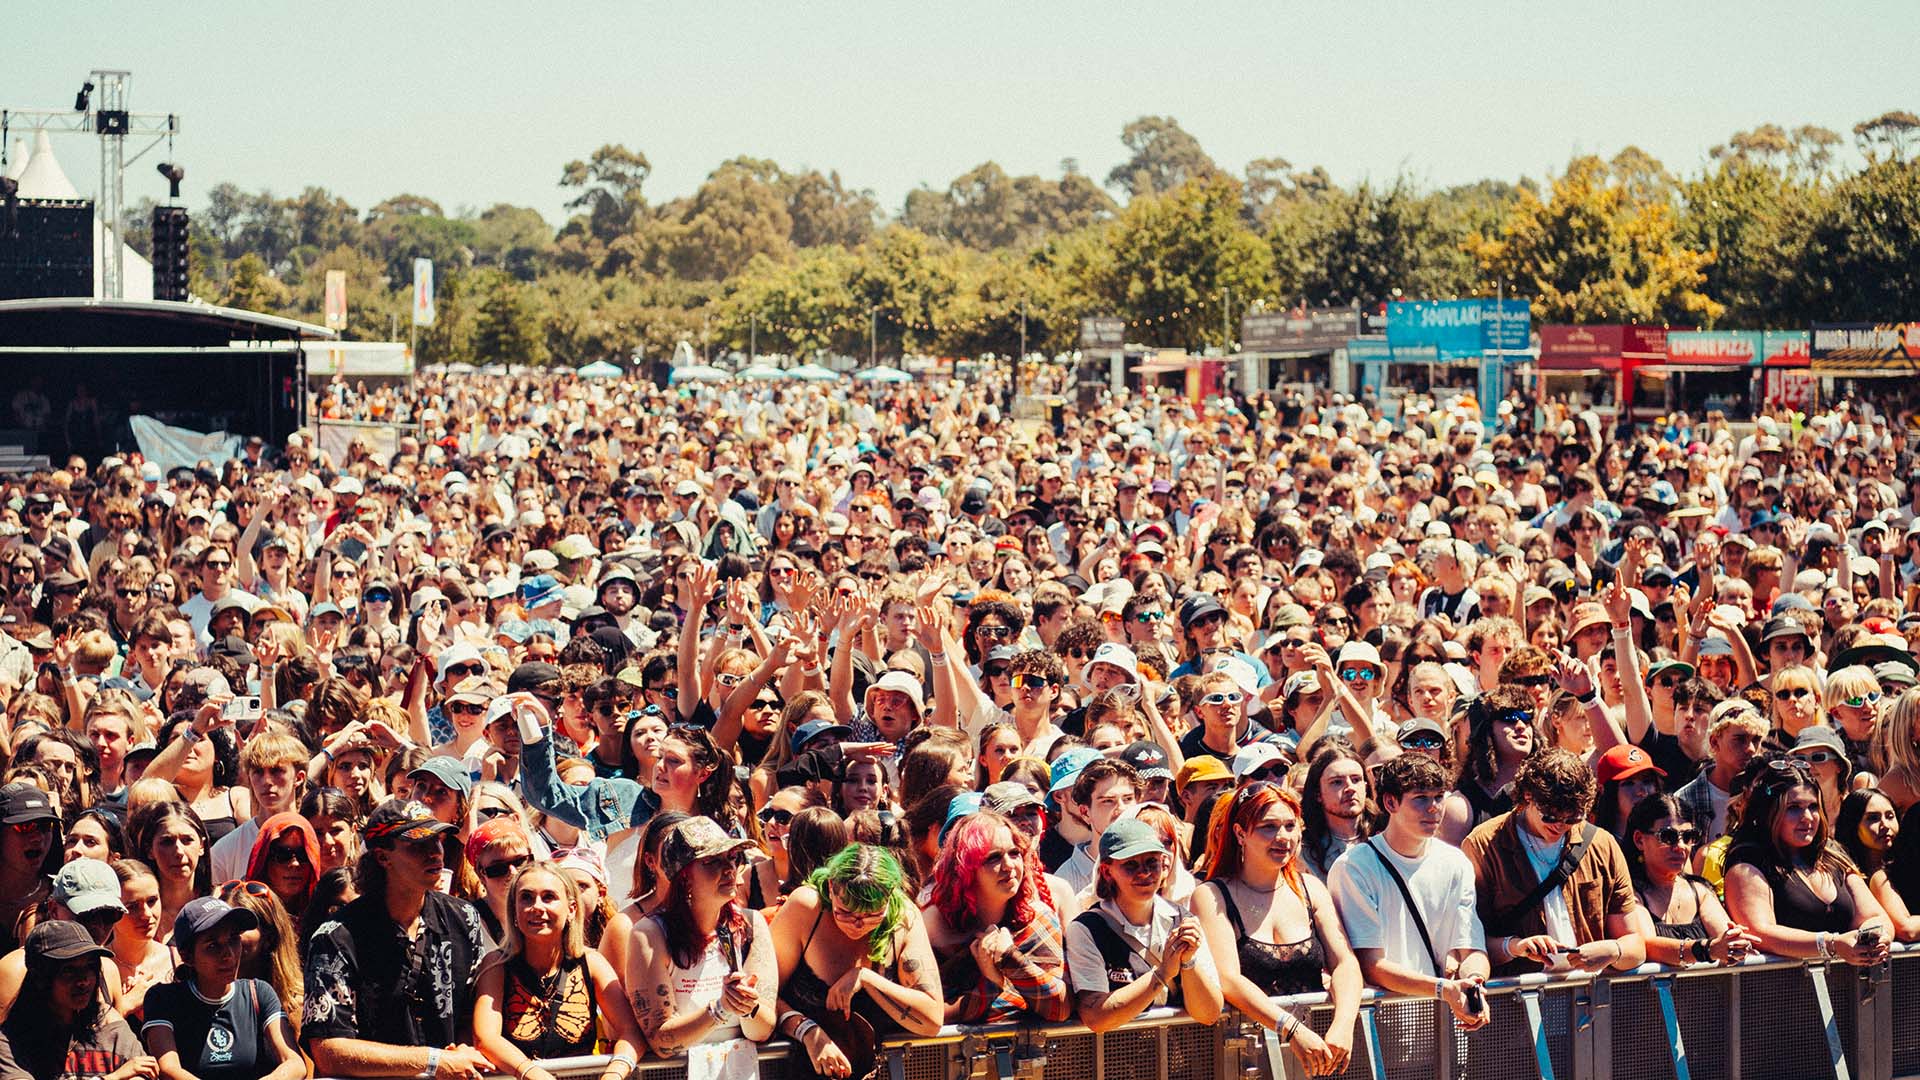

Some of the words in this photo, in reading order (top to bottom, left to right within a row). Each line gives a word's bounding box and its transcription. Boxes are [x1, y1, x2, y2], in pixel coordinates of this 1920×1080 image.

[1422, 305, 1481, 327] SOUVLAKI
[1671, 338, 1718, 356] EMPIRE
[1719, 338, 1755, 356] PIZZA
